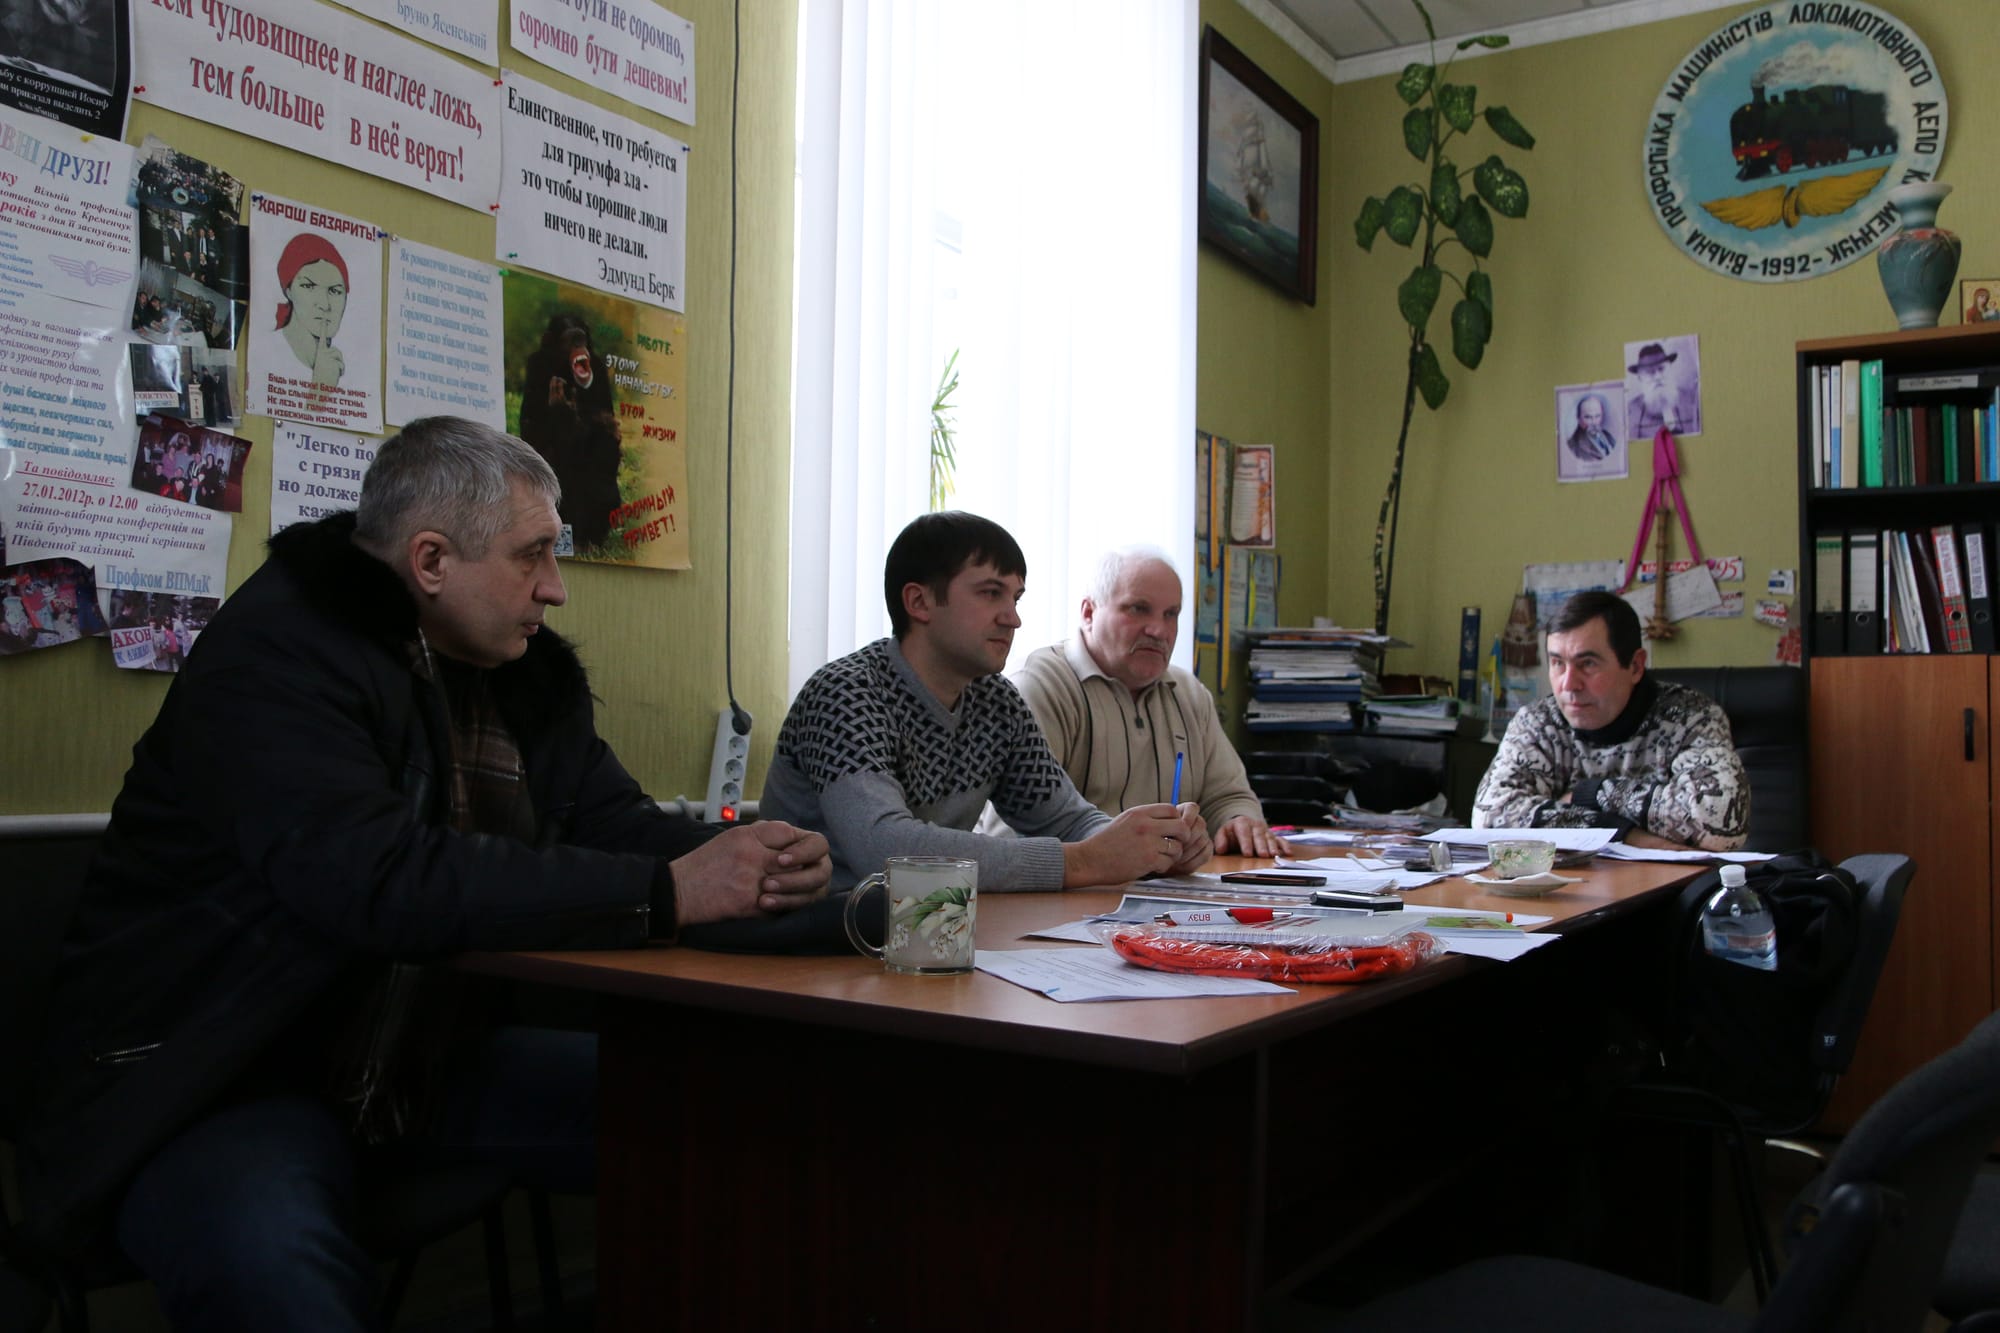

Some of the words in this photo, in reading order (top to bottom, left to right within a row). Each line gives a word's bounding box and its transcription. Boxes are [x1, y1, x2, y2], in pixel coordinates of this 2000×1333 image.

[432, 14, 487, 50] Ясенський
[611, 4, 627, 31] не
[629, 14, 685, 66] соромно,
[202, 0, 339, 75] чудовищнее
[344, 53, 356, 84] и
[362, 60, 426, 111] наглее
[430, 89, 482, 140] ложь,
[519, 10, 578, 57] соромно
[586, 34, 618, 75] бути
[624, 58, 688, 104] дешевим!
[1789, 2, 1933, 88] ЛОКОМОТИВНОГО
[1912, 100, 1939, 156] ДЕПО
[190, 57, 235, 100] тем
[240, 65, 324, 130] больше
[350, 116, 362, 146] в
[368, 121, 399, 160] неё
[405, 137, 464, 184] верят!
[507, 86, 599, 145] Единственное,
[602, 129, 624, 151] что
[626, 137, 677, 173] требуется
[40, 145, 111, 185] ДРУЗІ!
[542, 142, 564, 164] для
[567, 150, 621, 187] триумфа
[624, 170, 641, 192] зла
[0, 170, 18, 187] ку
[34, 185, 69, 202] Вільній
[80, 200, 132, 220] профспілці
[0, 201, 37, 219] років
[0, 190, 49, 209] отивного
[54, 203, 76, 217] депо
[82, 211, 132, 231] Кременчук
[521, 168, 542, 190] это
[545, 176, 582, 205] чтобы
[585, 192, 637, 224] хорошие
[638, 209, 668, 234] люди
[310, 211, 376, 242] БАЗАРИТЬ!
[544, 211, 585, 240] ничего
[588, 226, 602, 245] не
[604, 231, 648, 260] делали.
[598, 258, 646, 293] Эдмунд
[649, 272, 676, 302] Берк
[0, 338, 51, 355] спілковому
[606, 353, 639, 372] ЭТОМУ
[286, 431, 350, 457] "Легко
[642, 424, 676, 442] ЖИЗНИ
[24, 461, 39, 474] Та
[42, 463, 115, 485] повідомляє:
[298, 460, 307, 472] с
[312, 461, 360, 480] грязи
[22, 482, 94, 511] 27.01.2012р.
[108, 493, 138, 511] 12.00
[146, 502, 212, 521] відбудеться
[278, 479, 300, 493] но
[304, 483, 362, 502] долже
[608, 484, 676, 530] ОГРОМНЫЙ
[16, 501, 113, 525] звітно-виборна
[116, 515, 188, 536] конференція
[191, 526, 204, 536] на
[16, 519, 43, 532] якій
[46, 522, 91, 538] будуть
[94, 528, 149, 546] присутні
[152, 536, 206, 553] керівники
[623, 513, 676, 550] ПРИВЕТ!
[11, 533, 76, 552] Південної
[78, 544, 135, 560] залізниці.
[106, 564, 162, 590] Профком
